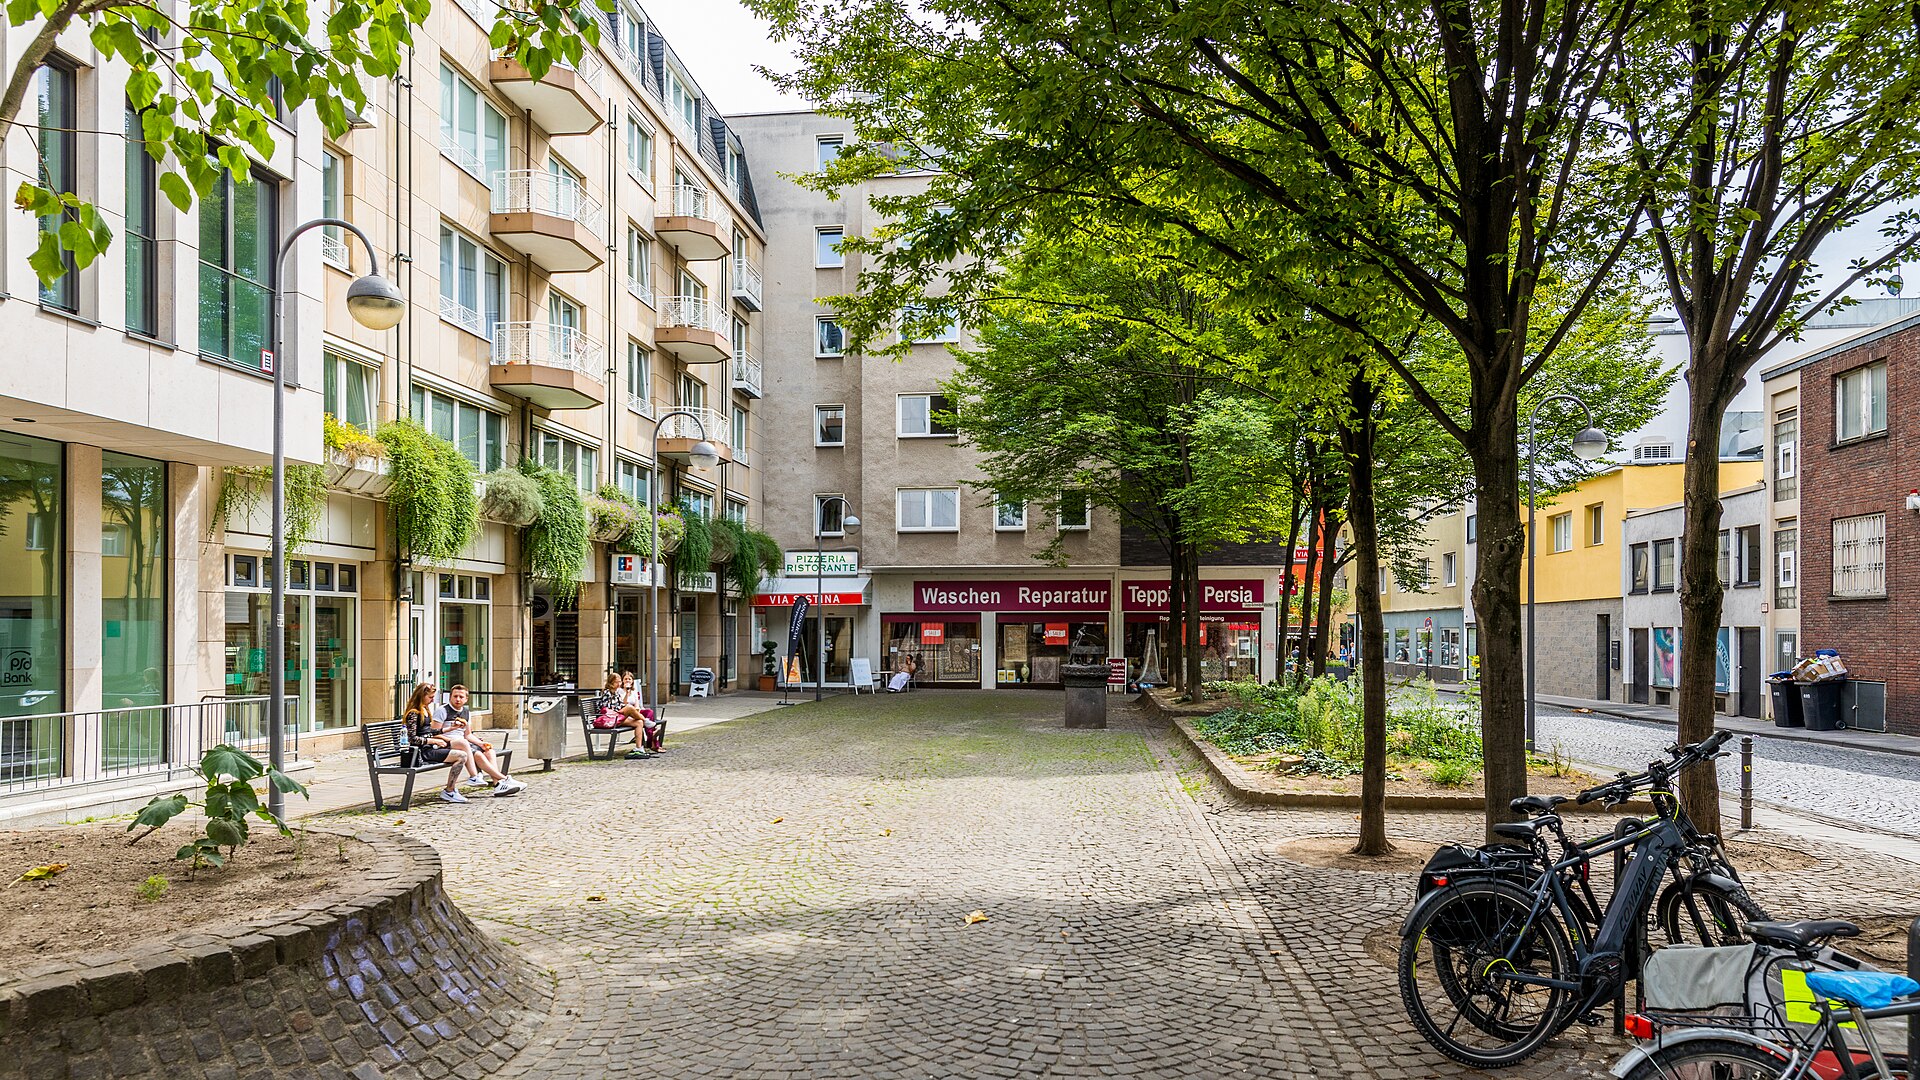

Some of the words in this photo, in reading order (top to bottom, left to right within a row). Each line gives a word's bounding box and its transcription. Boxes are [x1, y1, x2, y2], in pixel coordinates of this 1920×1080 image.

[796, 555, 846, 563] PIZZERIA
[786, 563, 857, 572] RISTORANTE
[921, 587, 1001, 604] Waschen
[1018, 586, 1108, 607] Reparatur
[1204, 585, 1253, 603] Persia
[769, 595, 789, 605] VIA
[4, 672, 32, 683] Bank
[1620, 866, 1648, 932] CONWAY
